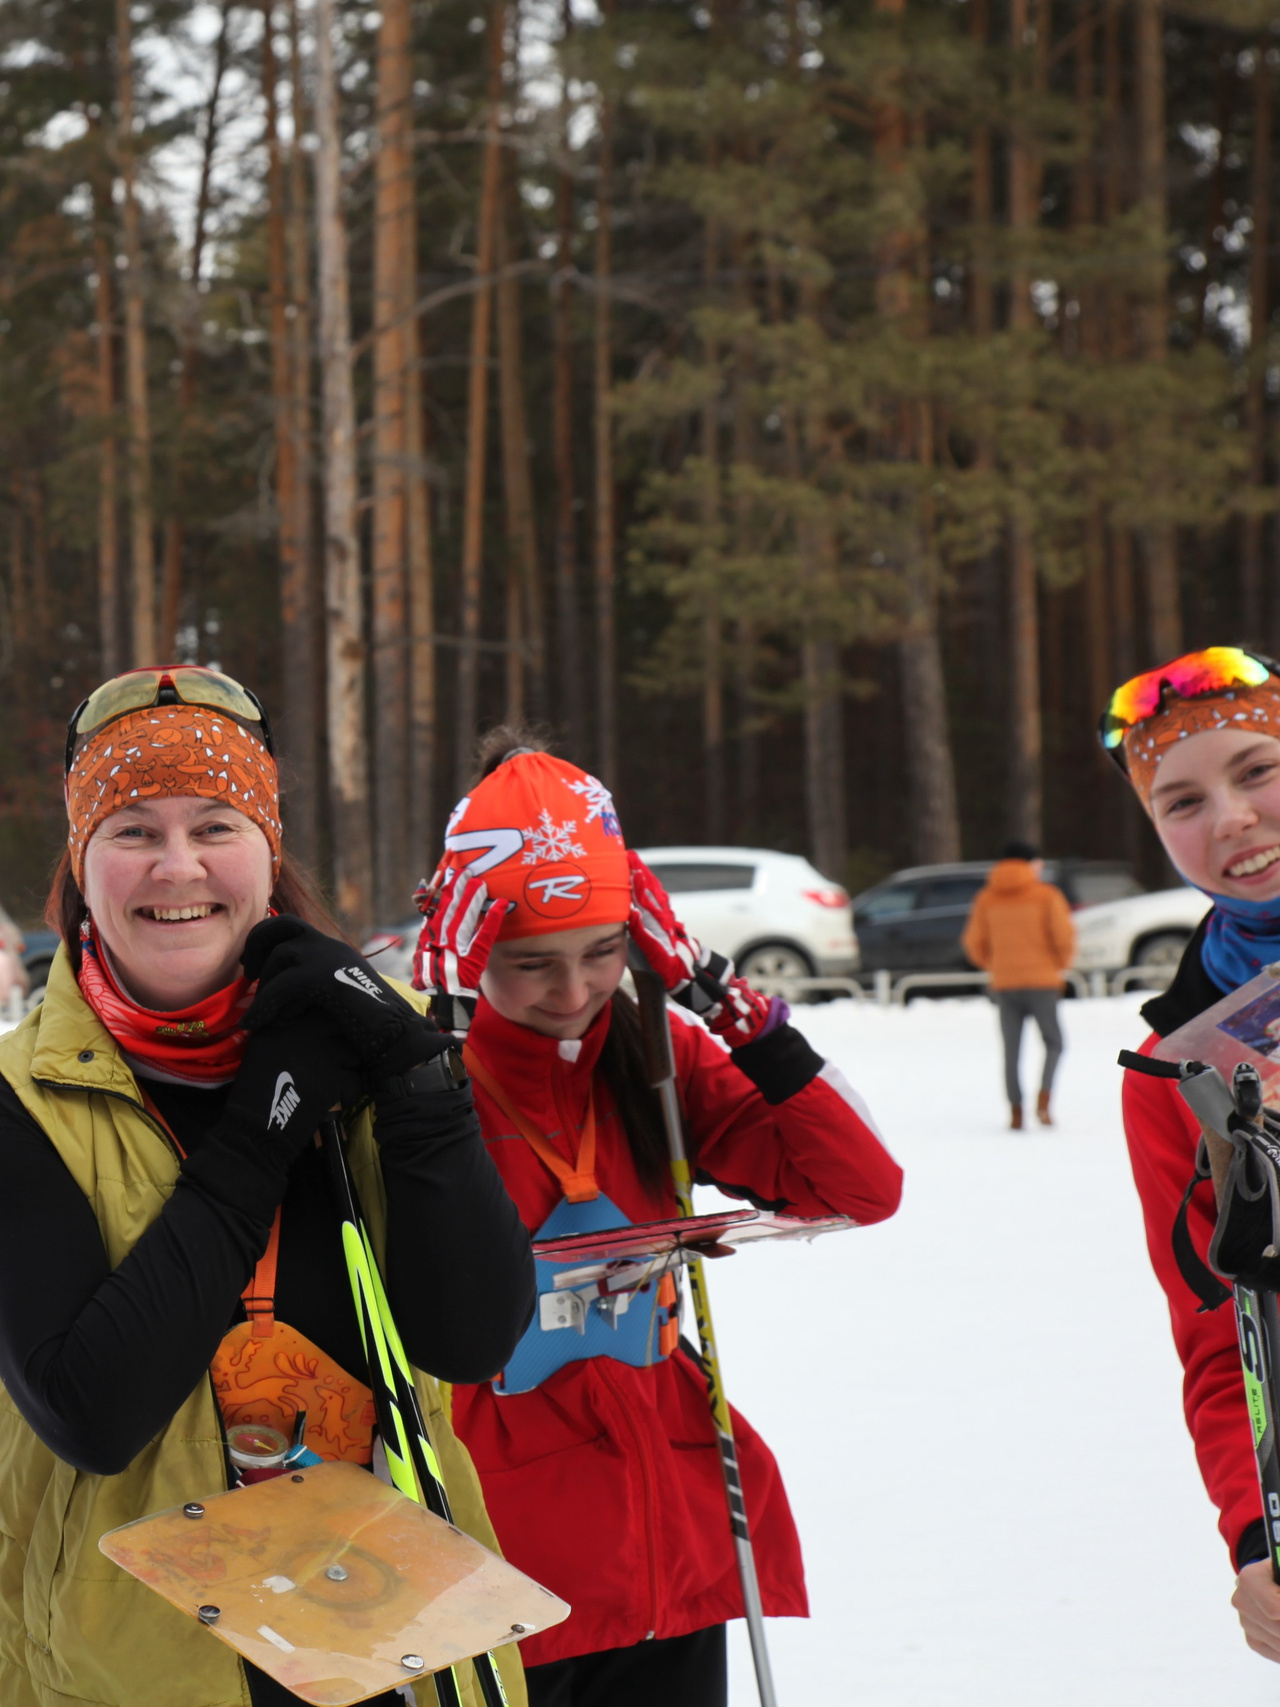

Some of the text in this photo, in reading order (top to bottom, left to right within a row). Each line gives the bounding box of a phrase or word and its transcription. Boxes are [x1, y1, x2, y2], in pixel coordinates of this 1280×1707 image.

[528, 875, 586, 904] R
[348, 966, 383, 995] NIKE
[276, 1085, 301, 1131] NIKE
